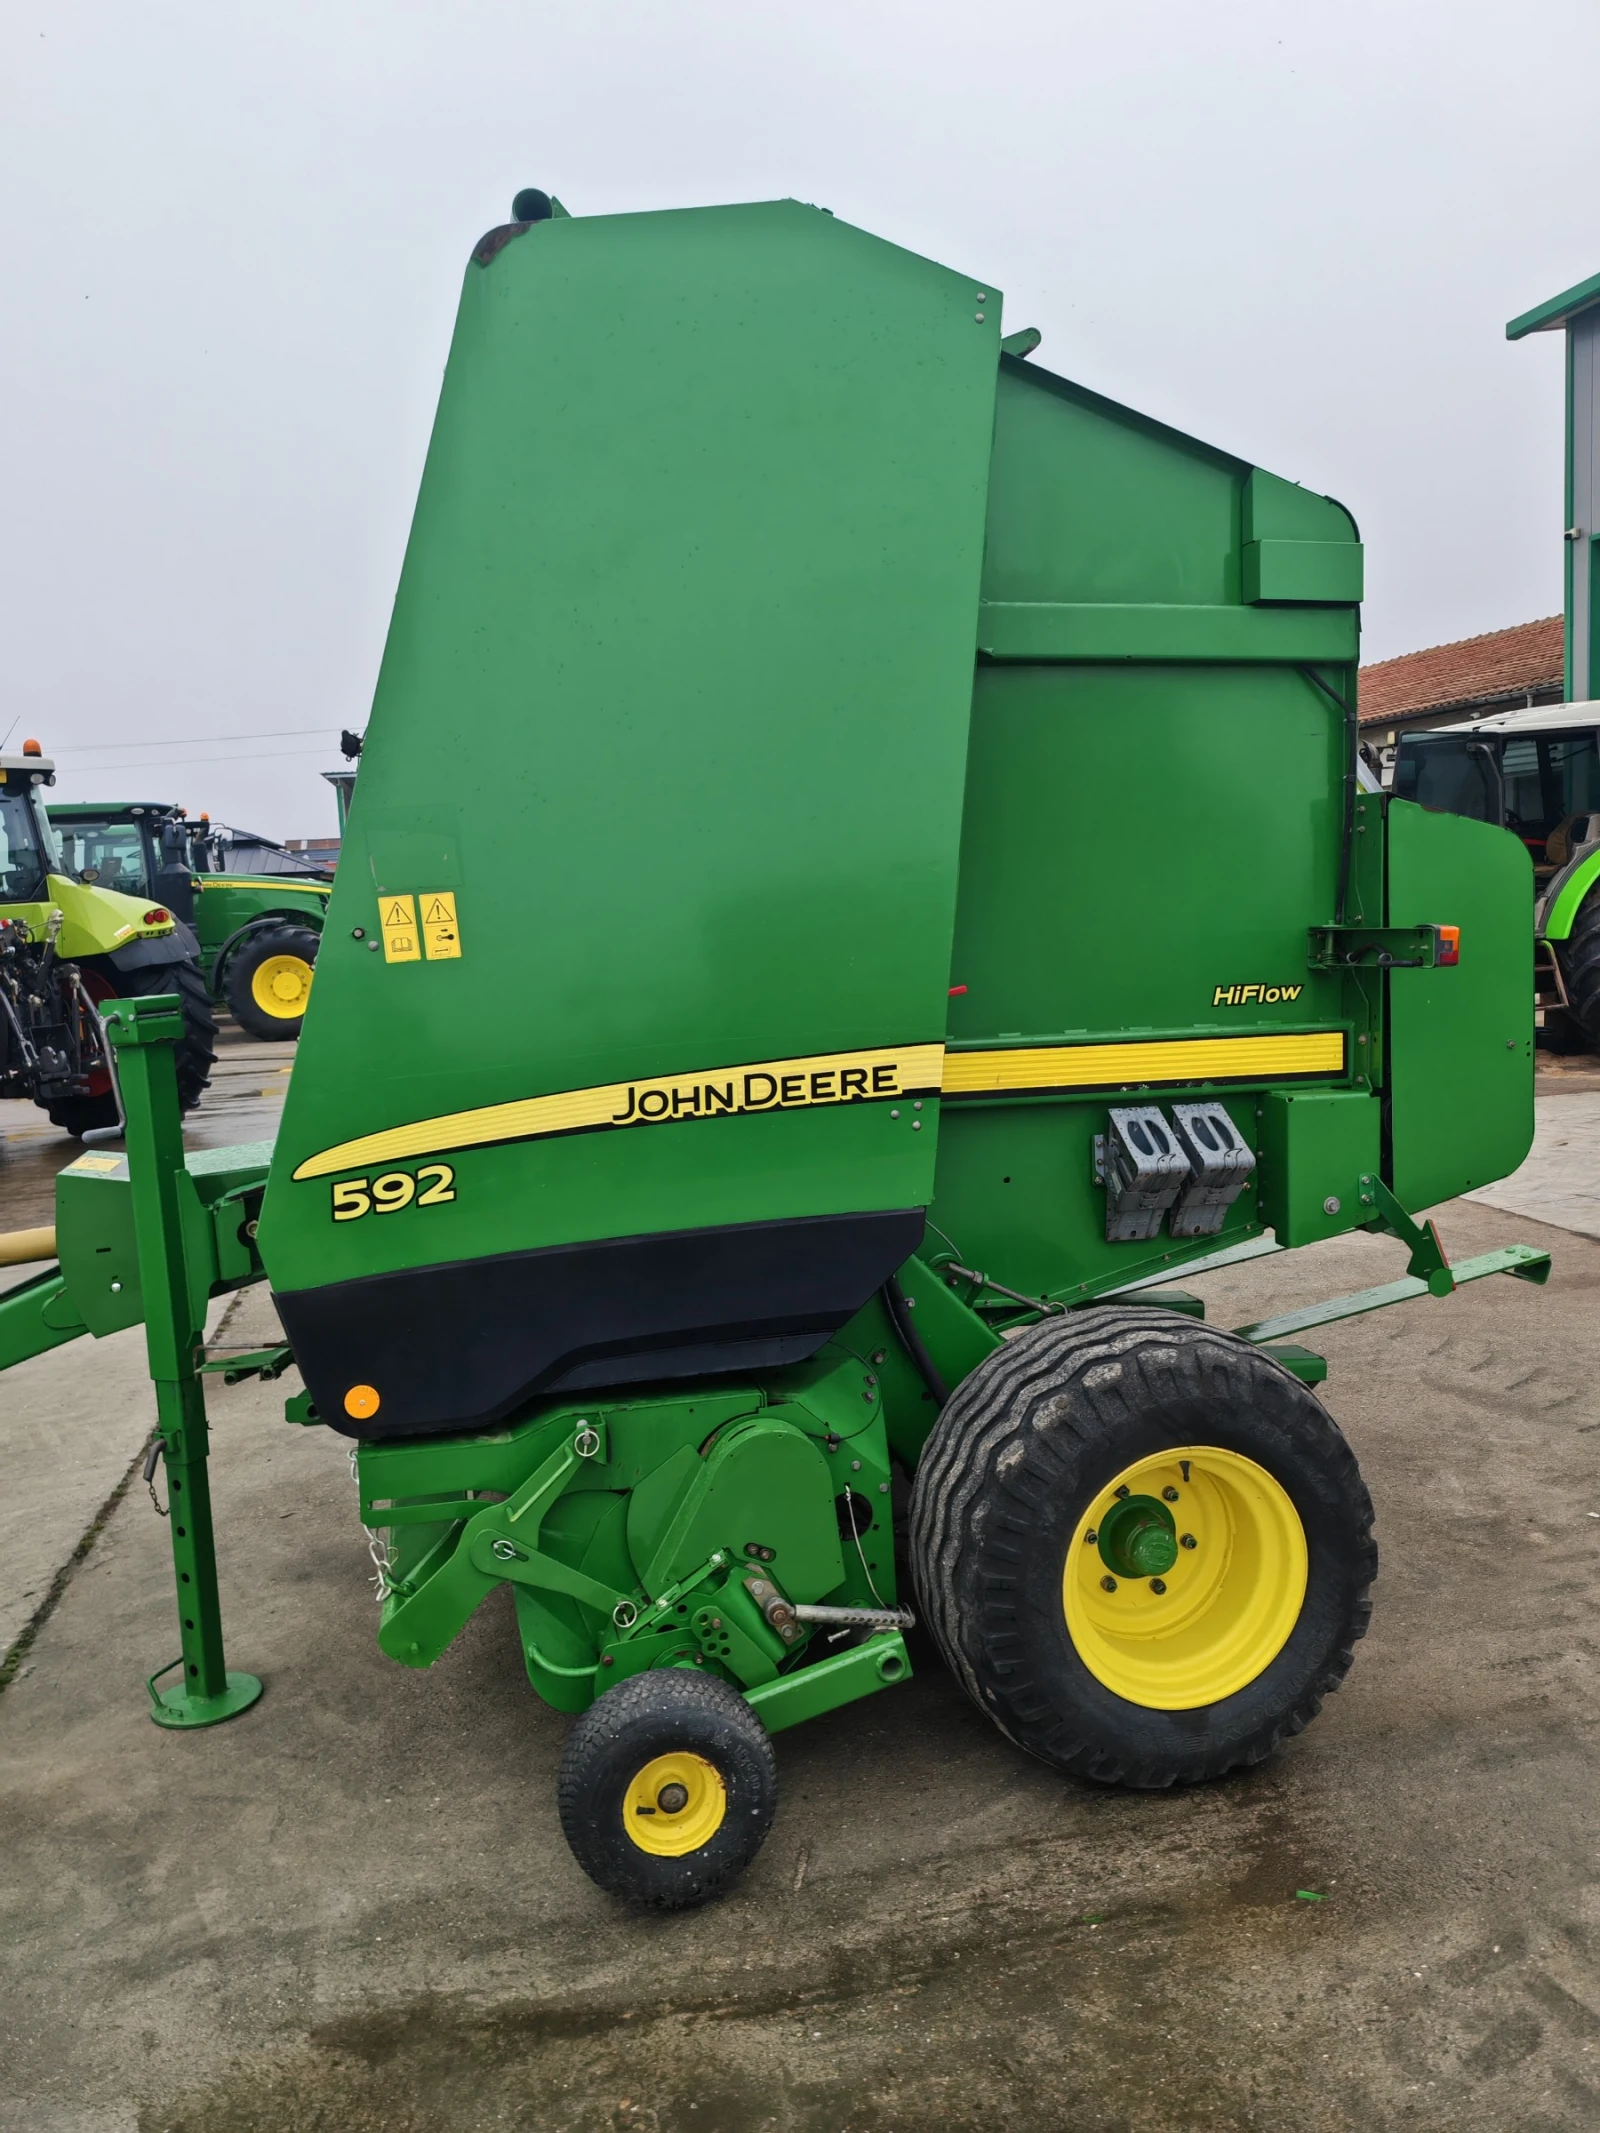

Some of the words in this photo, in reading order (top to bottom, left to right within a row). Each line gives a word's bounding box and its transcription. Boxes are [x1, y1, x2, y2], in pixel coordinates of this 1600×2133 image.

[1212, 984, 1303, 1006] HiFlow
[612, 1082, 734, 1121] JOHN
[744, 1064, 899, 1106] DEERE
[332, 1163, 457, 1222] 592
